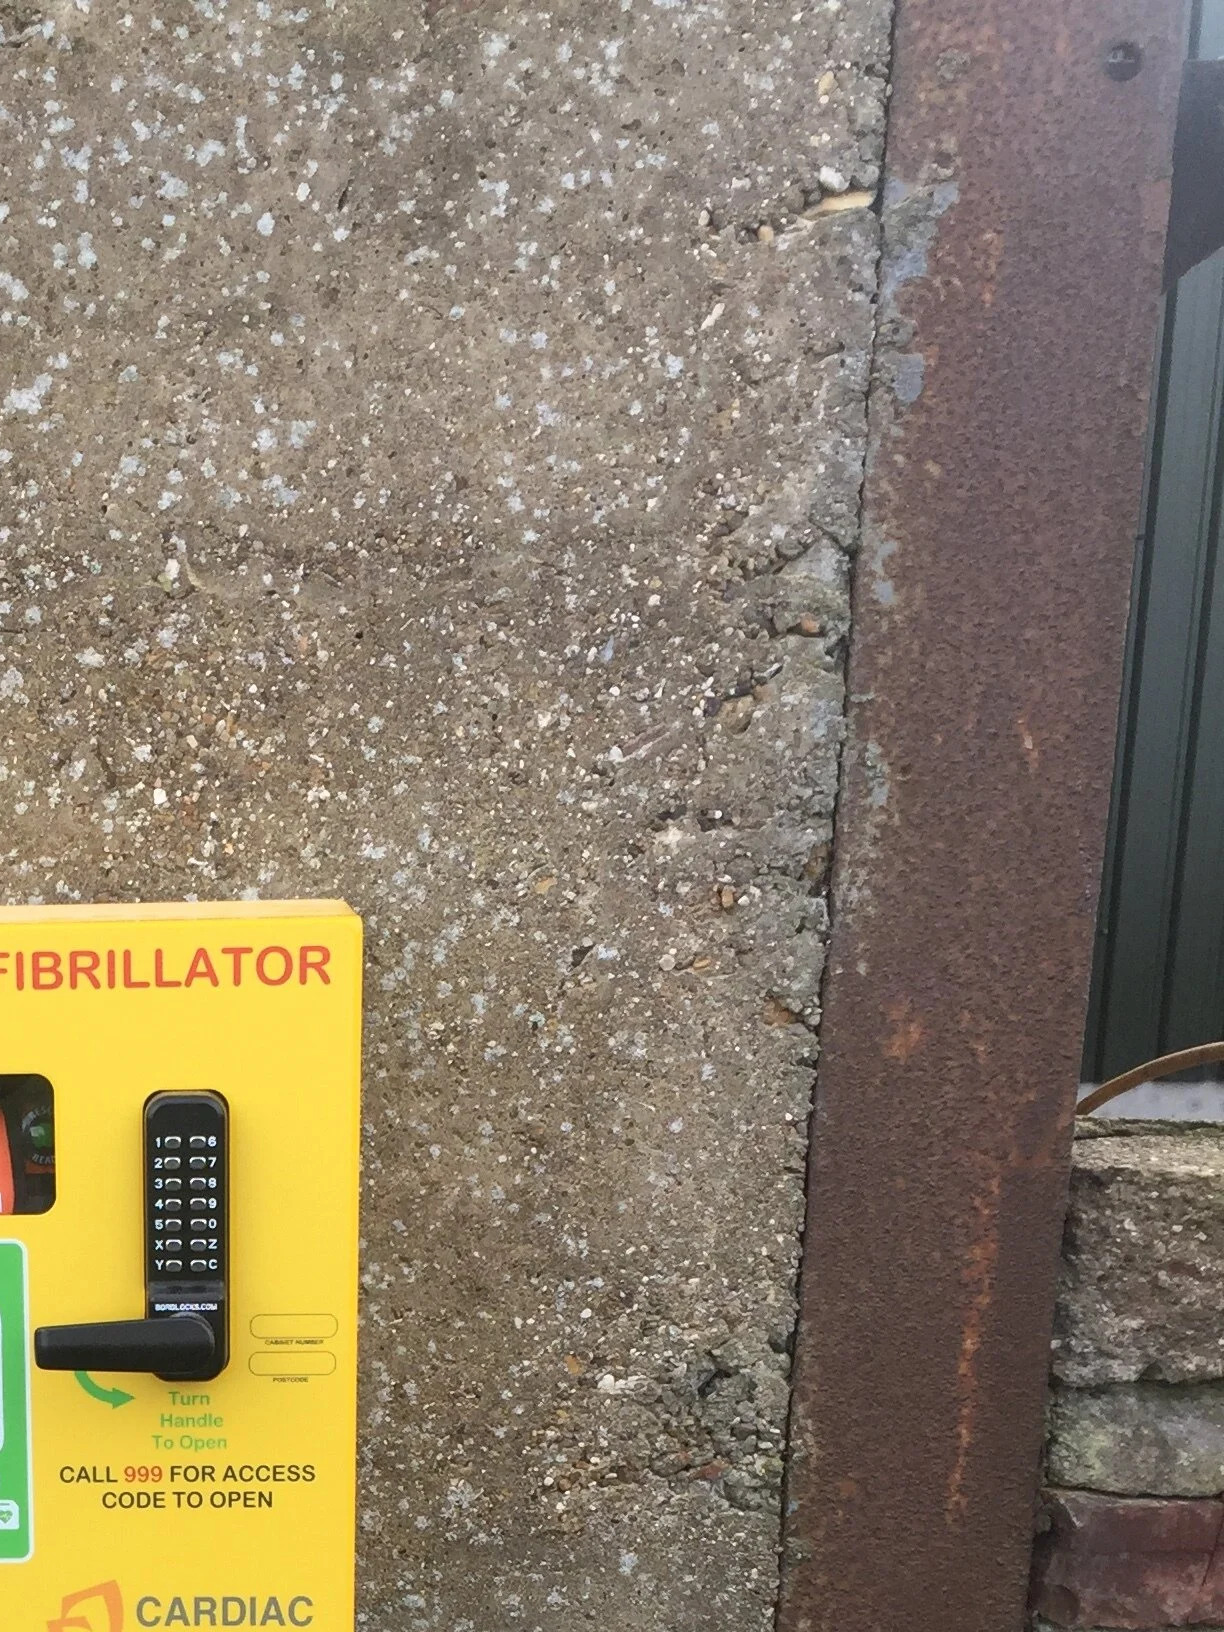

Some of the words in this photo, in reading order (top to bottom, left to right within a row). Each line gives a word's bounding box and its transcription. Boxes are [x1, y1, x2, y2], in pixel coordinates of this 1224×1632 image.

[155, 1137, 161, 1148] 1
[208, 1136, 217, 1147] 6
[154, 1158, 163, 1169] 2
[208, 1157, 217, 1168] 7
[154, 1178, 163, 1189] 3
[208, 1178, 217, 1188] 8
[154, 1199, 164, 1210] 4
[208, 1198, 217, 1209] 9
[154, 1219, 164, 1230] 5
[208, 1219, 217, 1229] 0
[155, 1240, 164, 1250] X
[208, 1239, 217, 1250] Z
[155, 1260, 164, 1270] Y
[208, 1259, 218, 1270] C
[168, 1391, 210, 1406] Turn
[160, 1413, 224, 1428] Handle
[152, 1435, 174, 1450] To
[180, 1435, 227, 1453] Open
[60, 1466, 118, 1483] CALL
[124, 1466, 163, 1483] 999
[170, 1465, 216, 1482] FOR
[223, 1465, 316, 1482] ACCESS
[102, 1491, 166, 1508] CODE
[172, 1491, 203, 1508] TO
[210, 1491, 273, 1508] OPEN
[136, 1596, 314, 1627] CARDIAC
